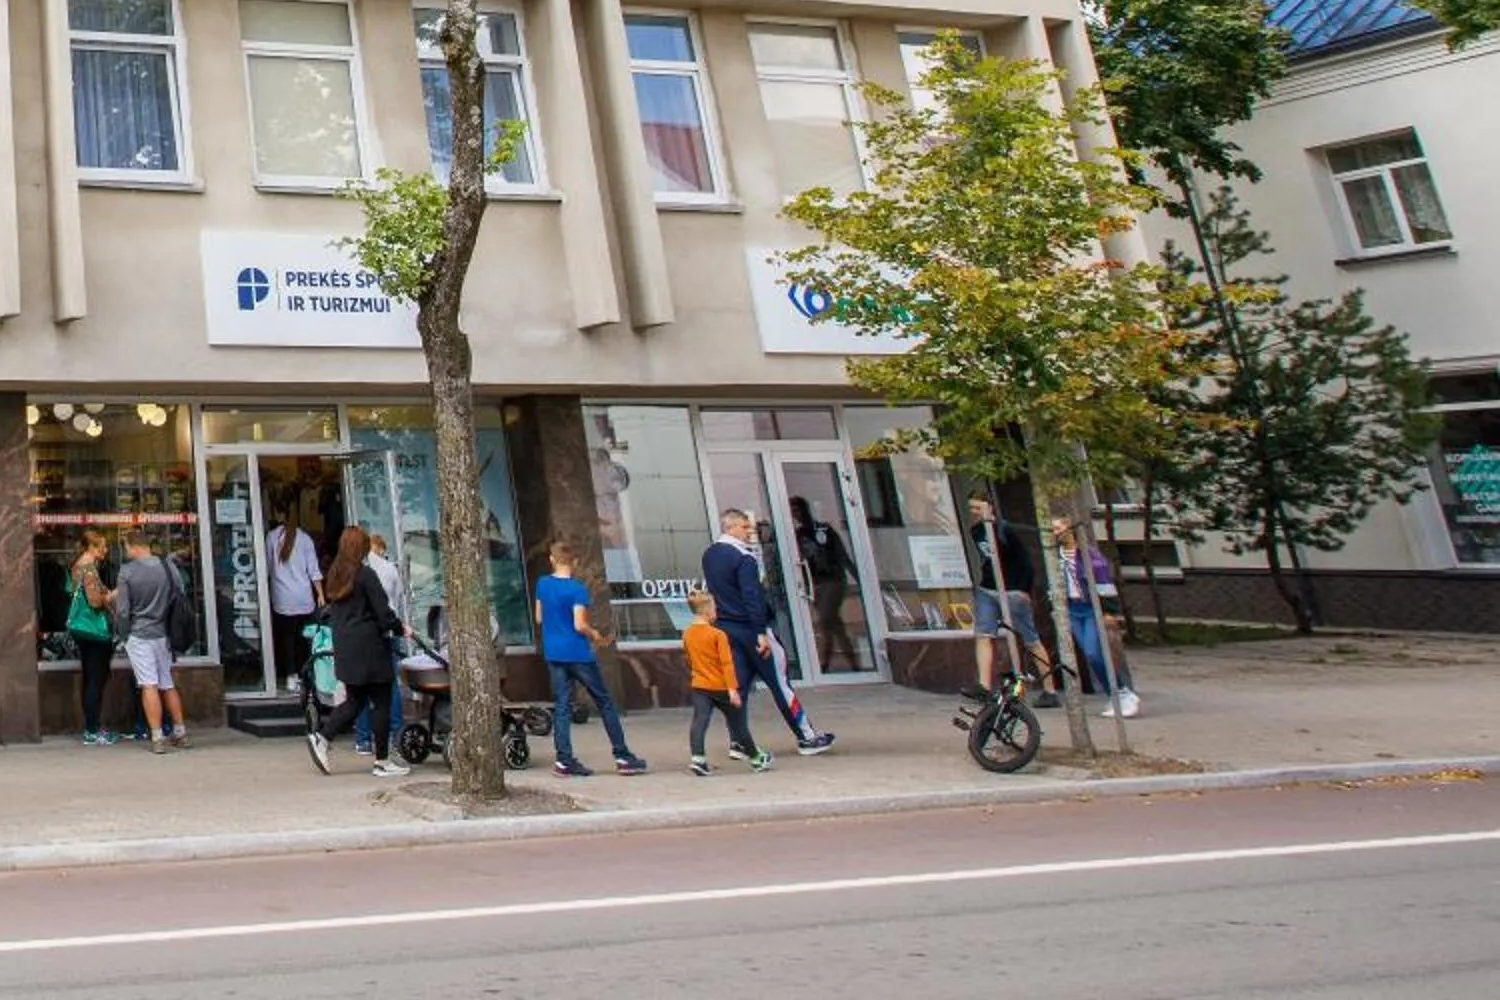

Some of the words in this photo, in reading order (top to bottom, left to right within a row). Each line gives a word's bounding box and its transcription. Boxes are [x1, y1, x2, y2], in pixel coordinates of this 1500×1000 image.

[285, 269, 351, 288] PREKĖS
[287, 296, 305, 311] IR
[310, 296, 391, 313] TURIZMUI
